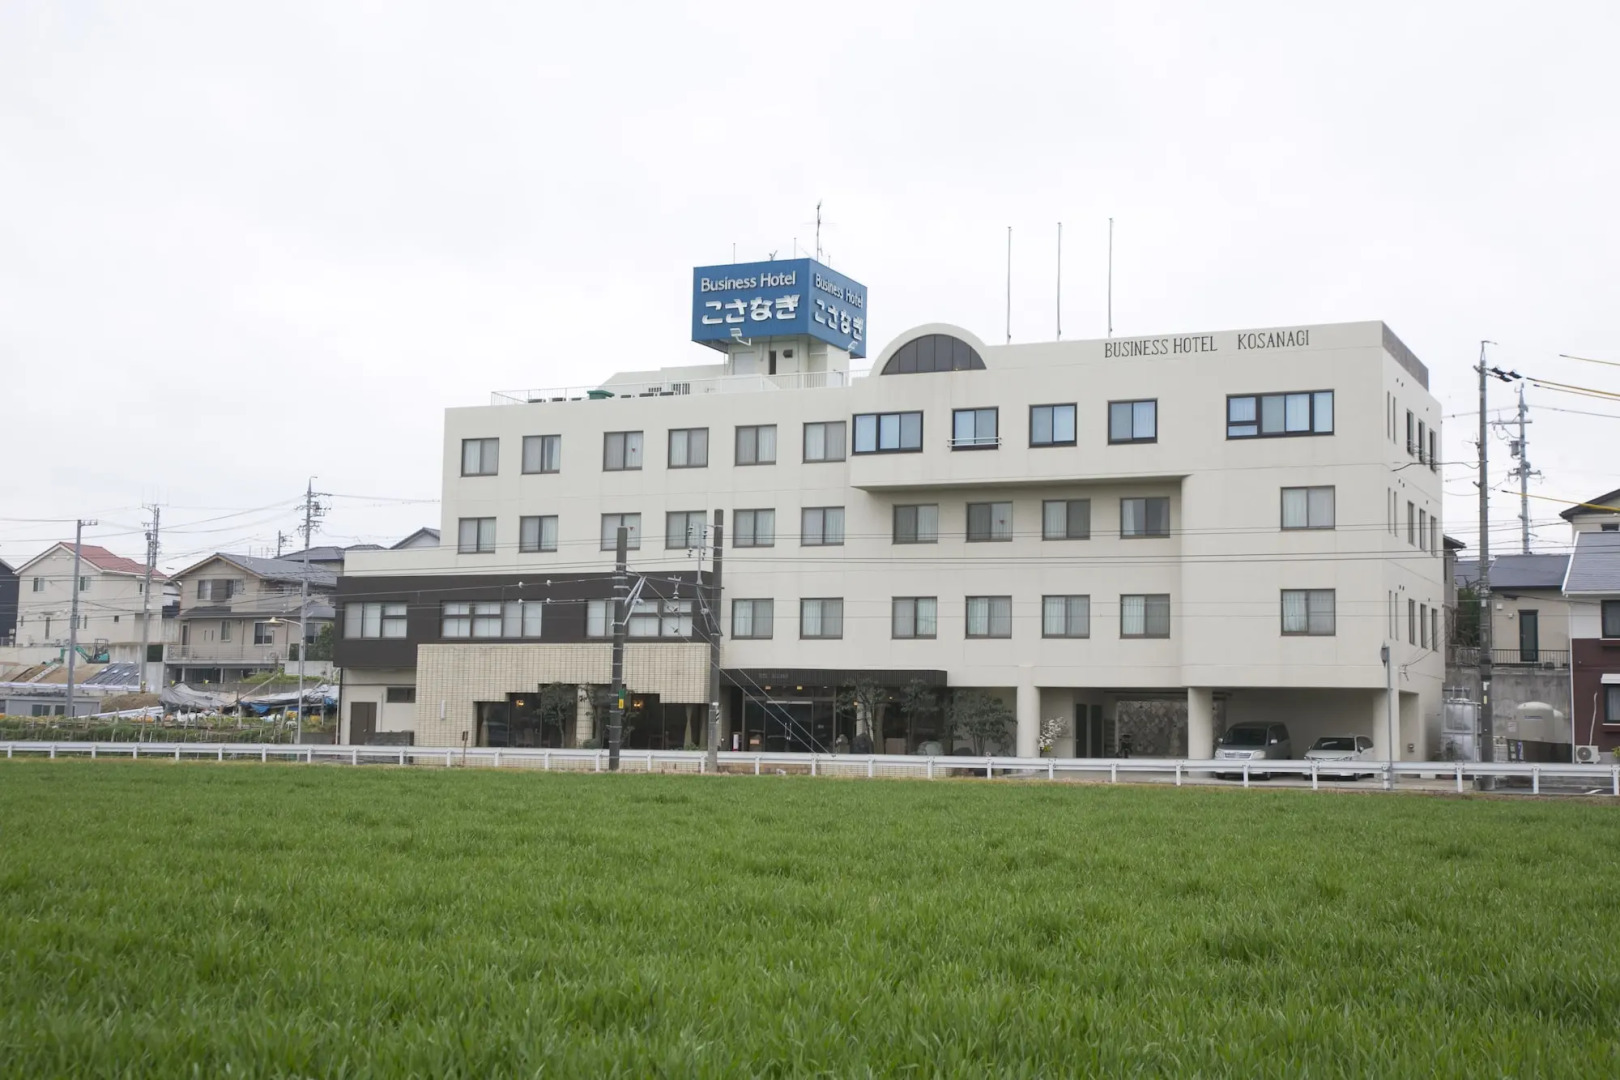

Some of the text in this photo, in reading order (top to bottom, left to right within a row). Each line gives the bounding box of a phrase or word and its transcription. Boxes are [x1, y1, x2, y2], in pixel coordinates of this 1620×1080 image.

[701, 270, 796, 292] Business Hotel
[815, 273, 863, 309] Business Hotel
[702, 294, 800, 325] こさなぎ
[814, 299, 864, 341] こさなぎ
[1104, 329, 1310, 358] BUSINESS HOTEL KOSANAGI
